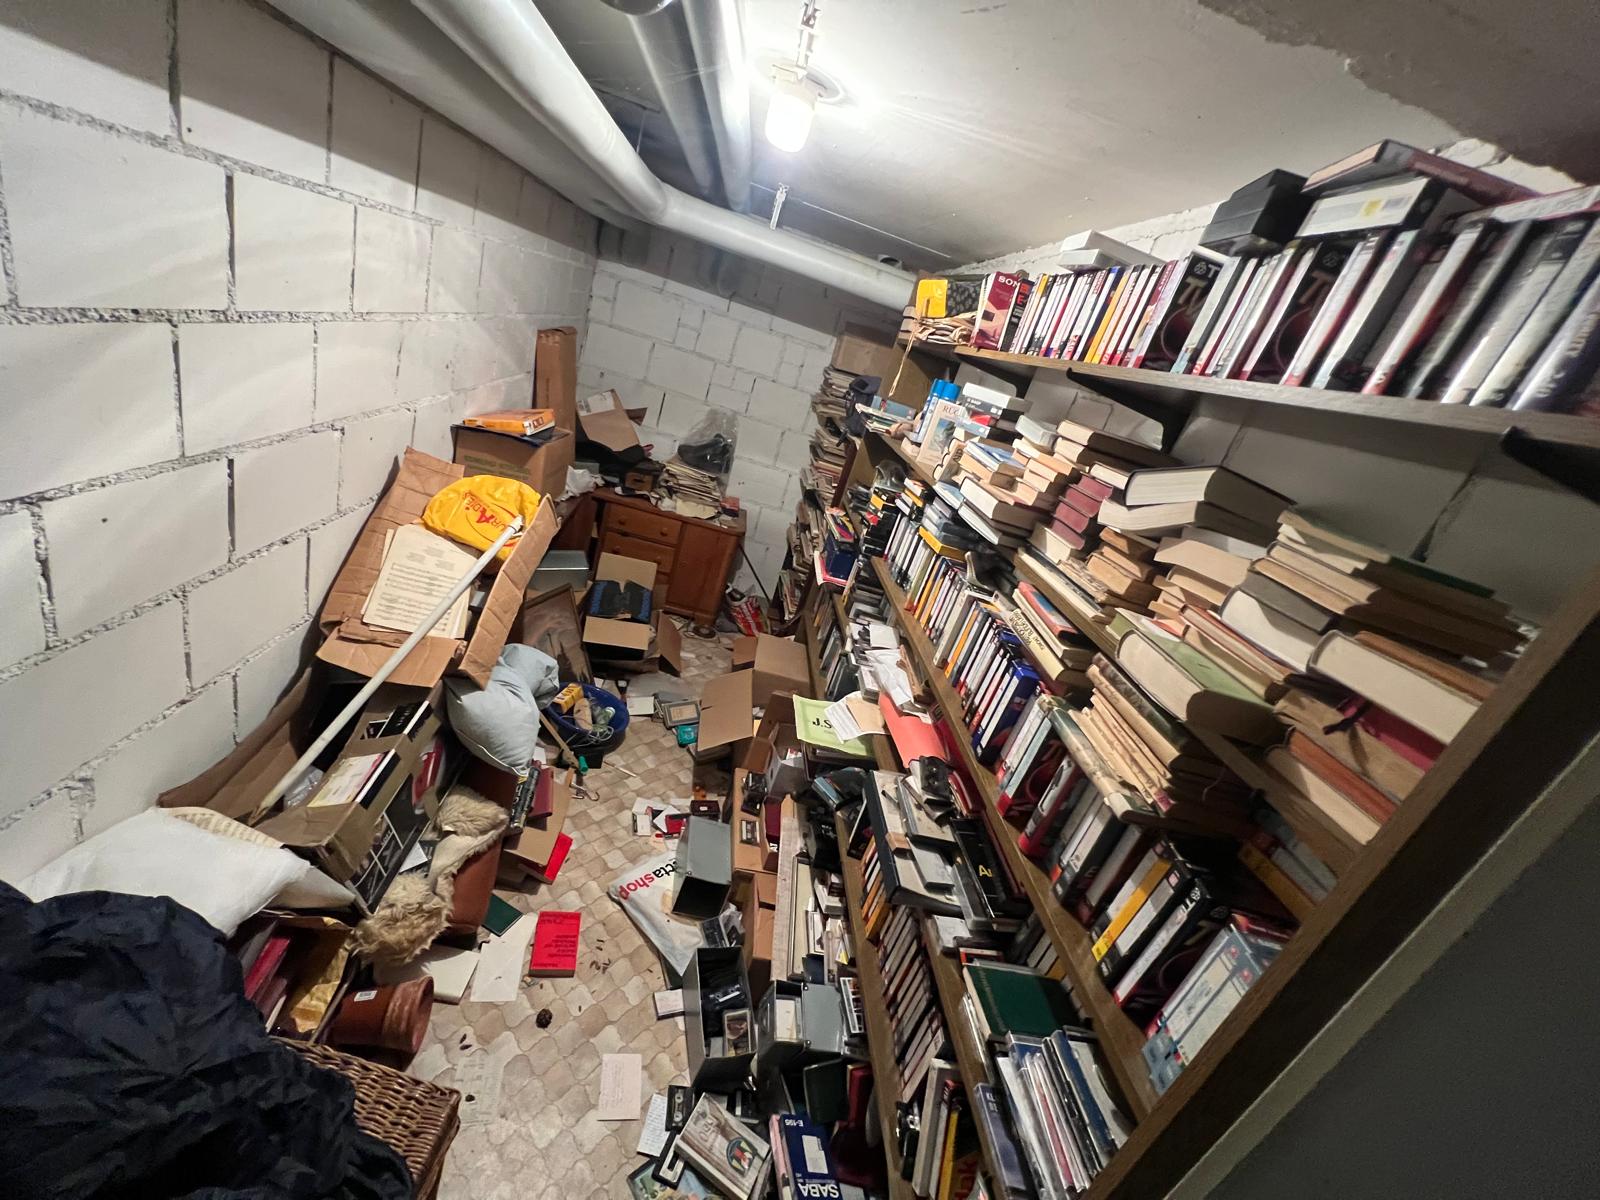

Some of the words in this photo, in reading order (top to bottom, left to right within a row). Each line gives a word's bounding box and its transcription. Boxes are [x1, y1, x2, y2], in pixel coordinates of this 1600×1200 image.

[997, 275, 1021, 288] SON
[617, 856, 680, 901] ctashop
[797, 1182, 842, 1200] SABA
